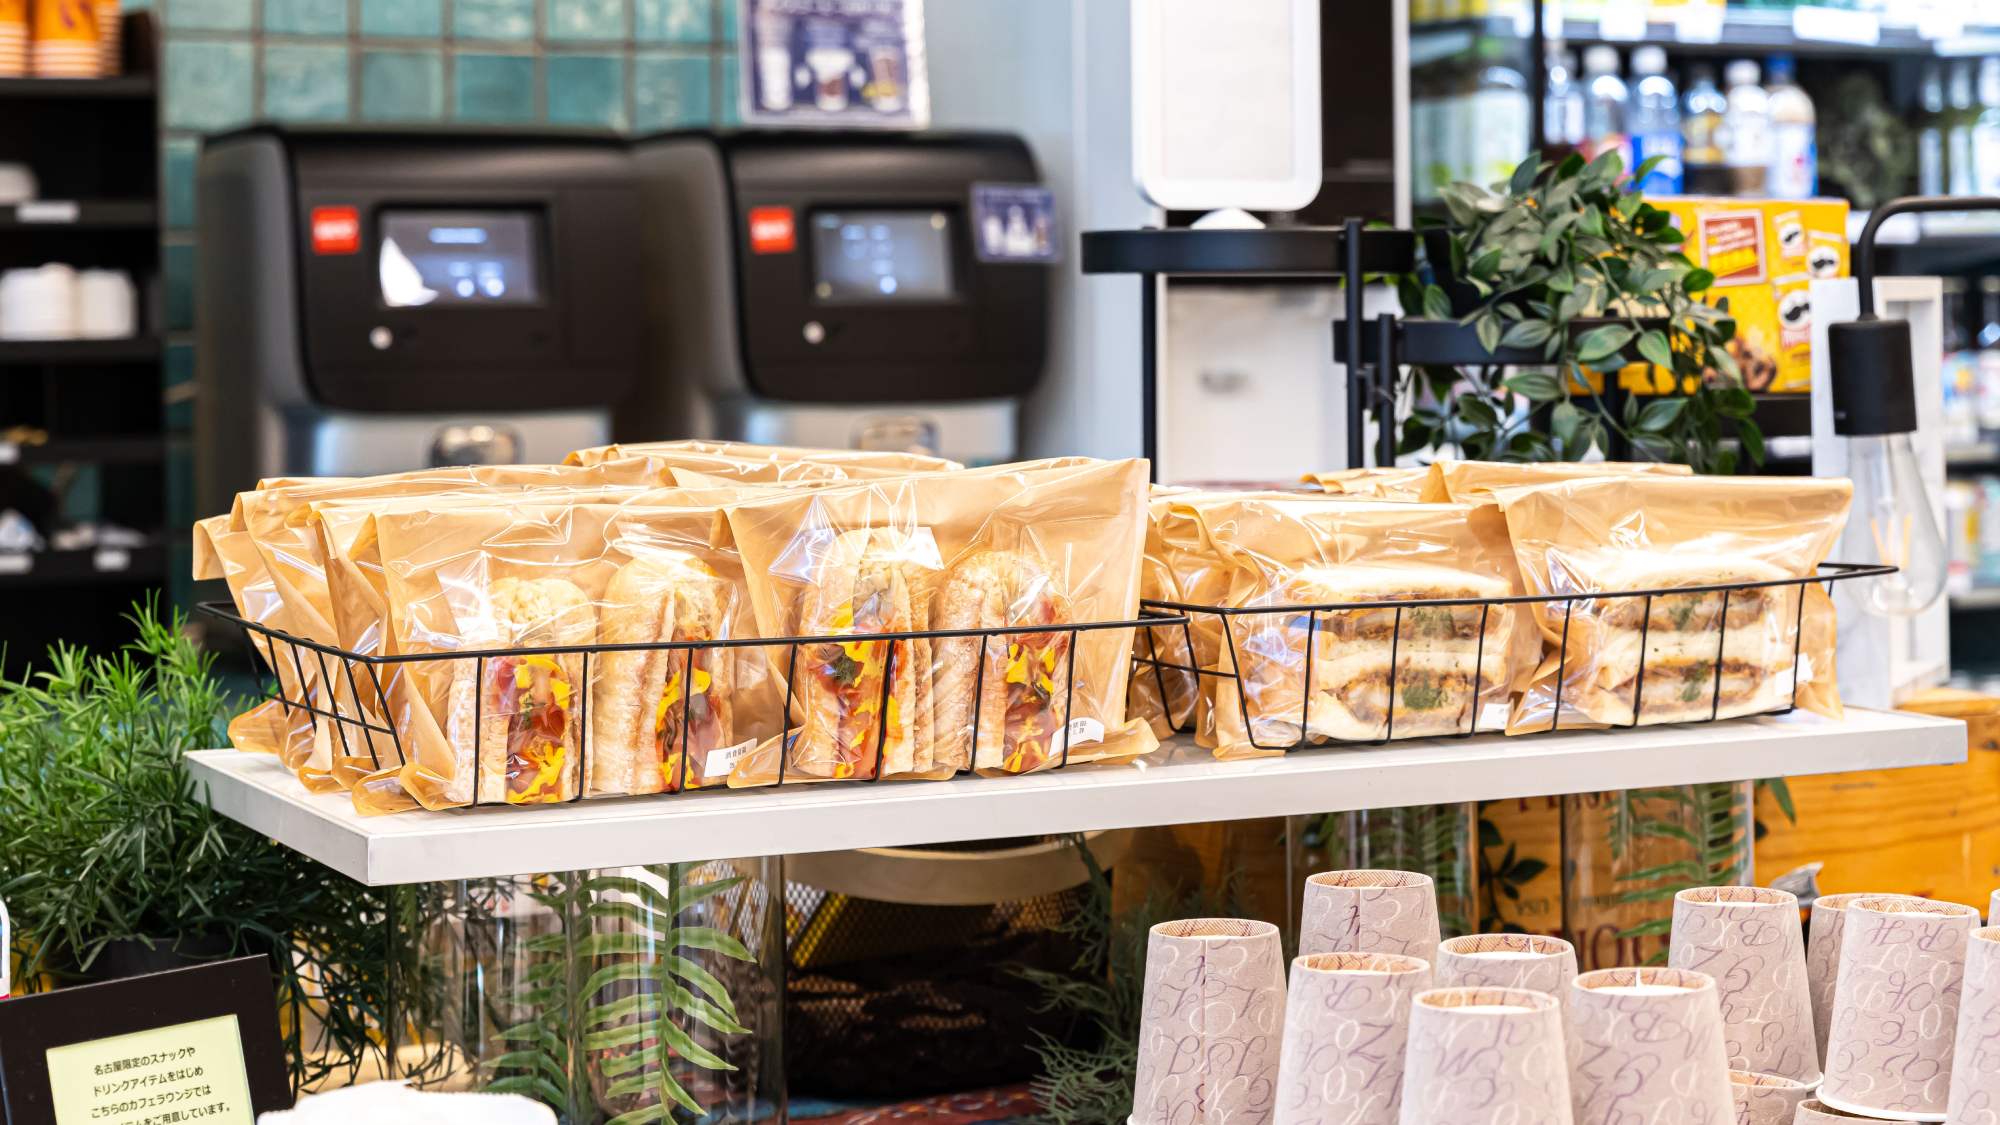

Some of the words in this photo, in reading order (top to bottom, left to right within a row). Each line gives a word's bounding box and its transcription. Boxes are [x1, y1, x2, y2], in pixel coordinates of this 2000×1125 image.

[94, 1046, 196, 1076] 名古屋限定のスナックや
[93, 1066, 204, 1097] ドリンクアイテムをはじめ
[91, 1084, 212, 1119] こちらのカフェラウンジでは
